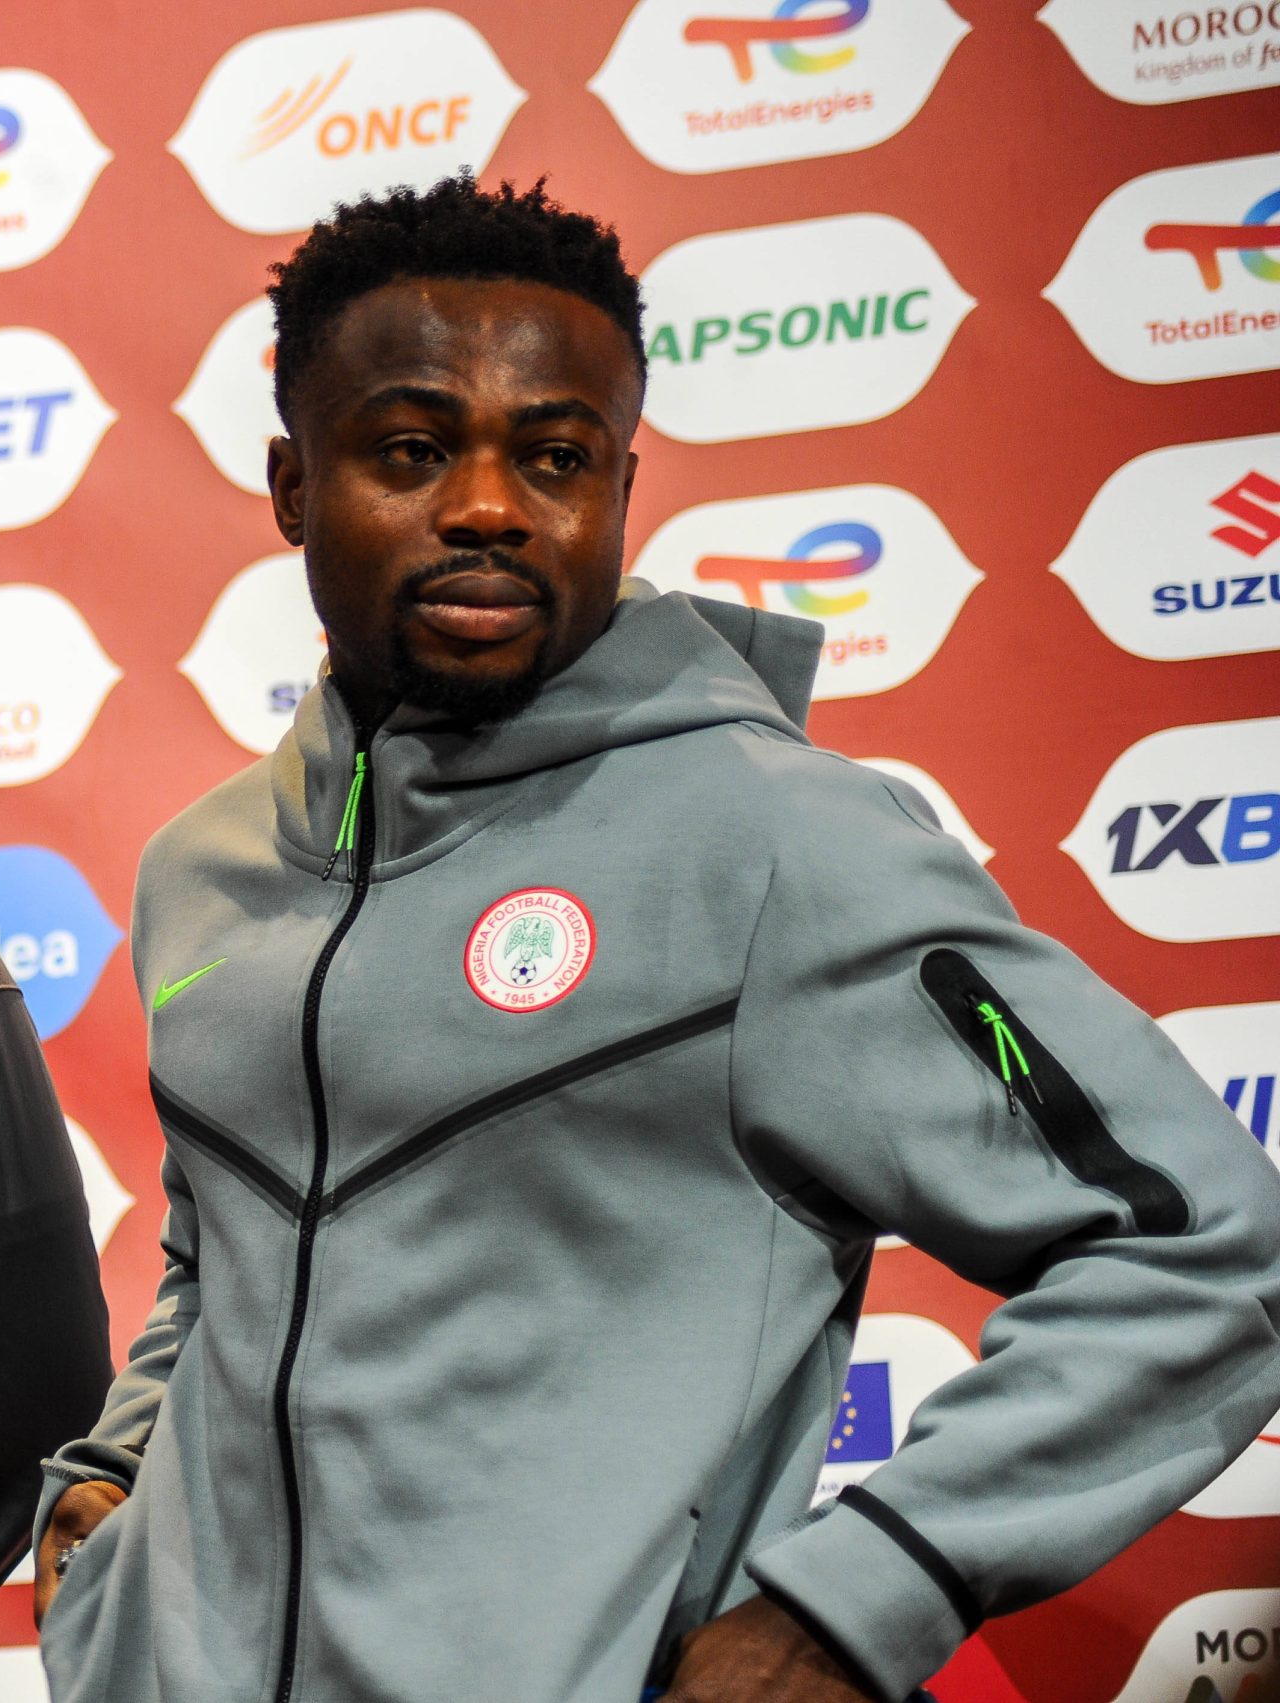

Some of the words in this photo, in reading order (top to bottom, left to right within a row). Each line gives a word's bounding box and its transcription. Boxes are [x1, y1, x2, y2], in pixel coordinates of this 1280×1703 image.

[317, 96, 471, 158] ONCF
[684, 88, 875, 135] TotalEnergies
[647, 289, 931, 365] APSONIC
[473, 930, 491, 987] NIGERIA
[488, 896, 560, 929] FOOTBALL
[553, 905, 587, 991] FEDERATION
[504, 992, 535, 1005] 1945
